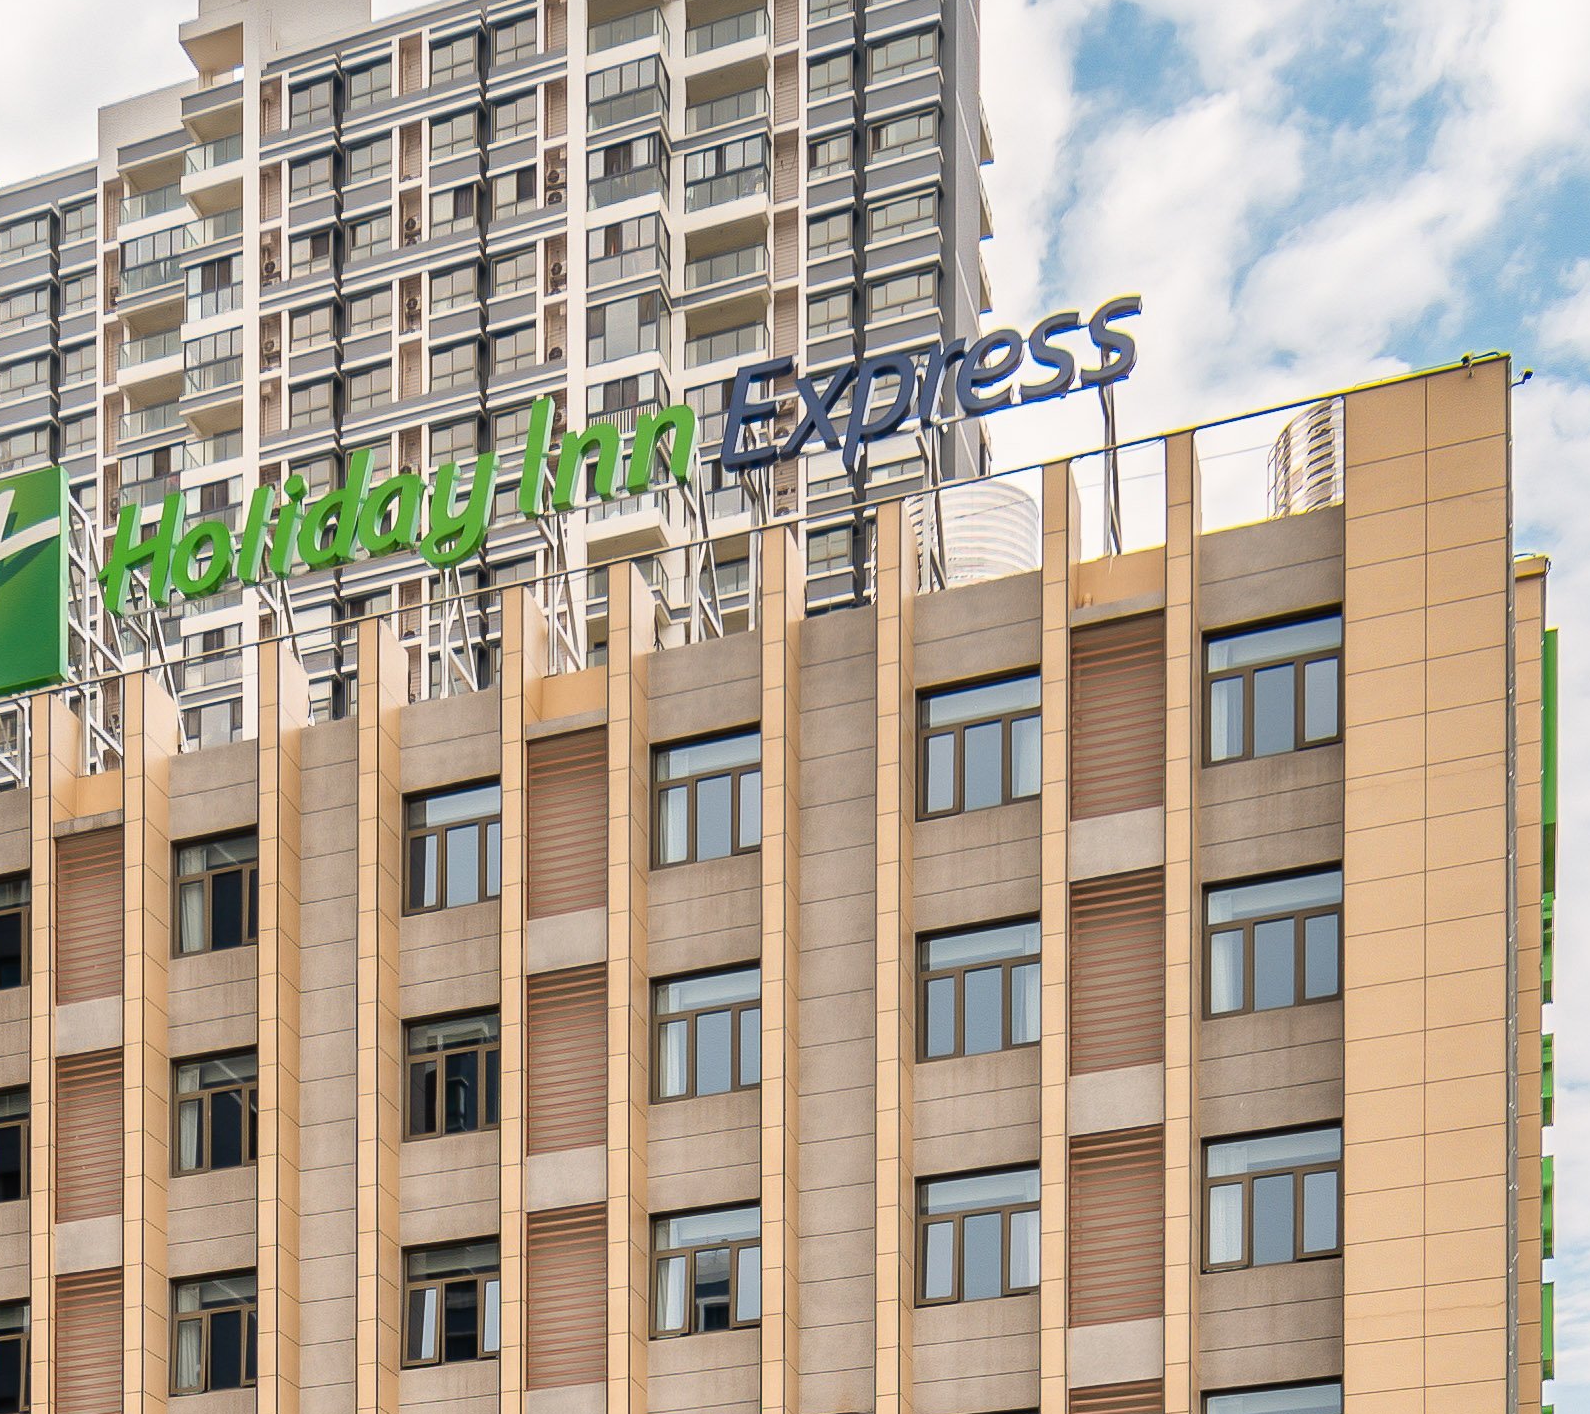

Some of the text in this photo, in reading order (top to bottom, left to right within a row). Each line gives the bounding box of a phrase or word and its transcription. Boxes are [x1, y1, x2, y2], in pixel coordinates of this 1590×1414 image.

[98, 448, 500, 617] Holiday
[518, 395, 701, 520] Inn
[719, 294, 1143, 474] Express
